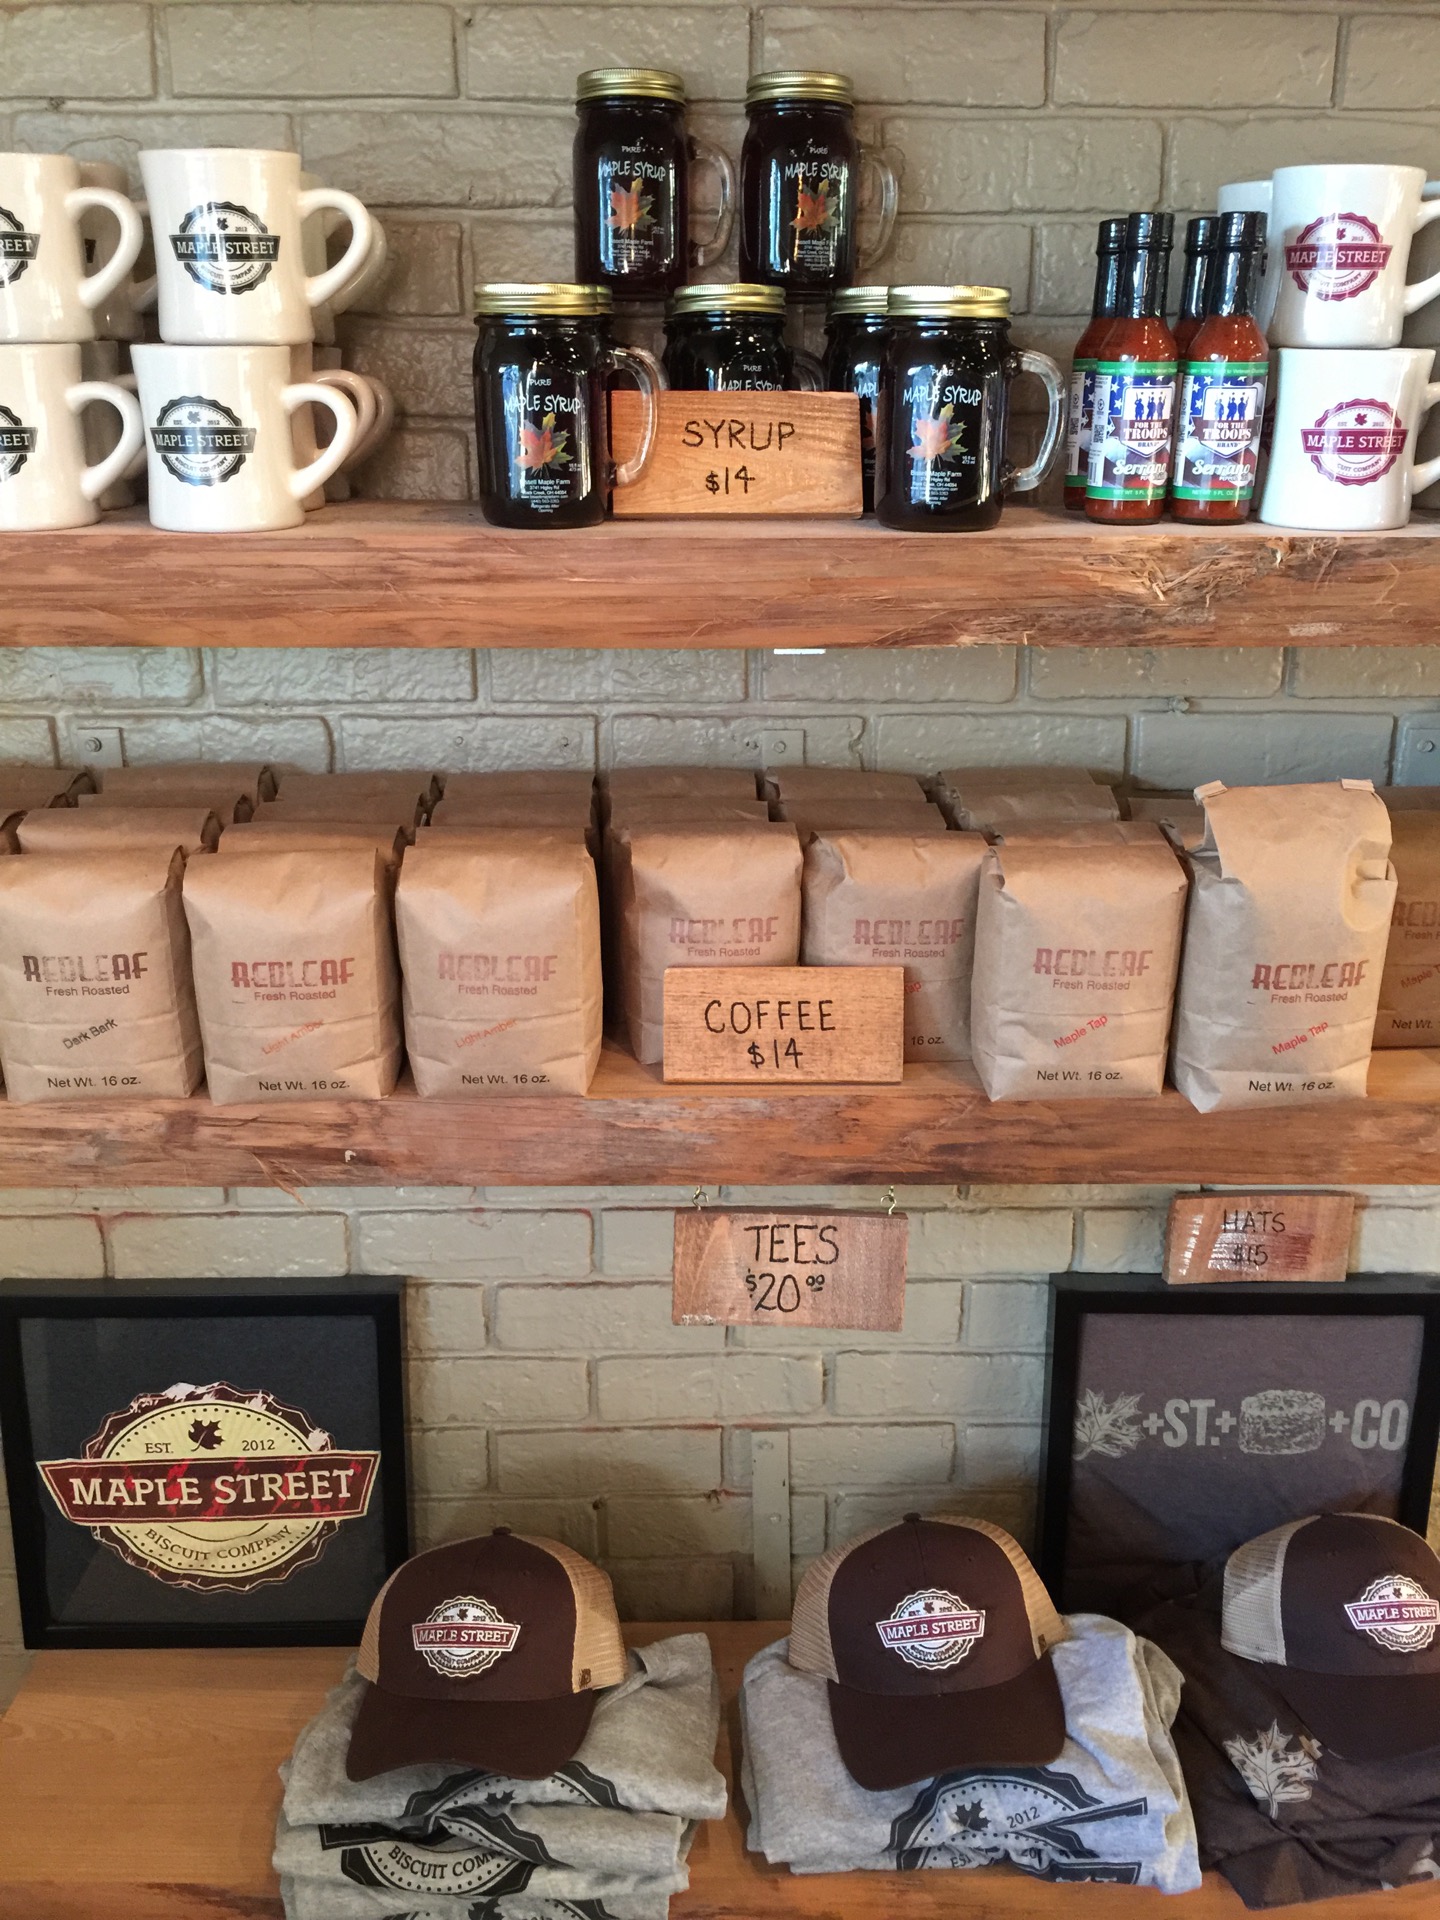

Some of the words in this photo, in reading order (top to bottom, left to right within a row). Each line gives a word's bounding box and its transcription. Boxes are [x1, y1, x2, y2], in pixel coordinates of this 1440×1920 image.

[632, 161, 667, 181] SYRUP
[785, 162, 818, 180] MAPLE
[177, 241, 219, 254] MAPLE
[225, 241, 275, 255] STREET
[1289, 251, 1334, 263] MAPLE
[1337, 251, 1386, 263] STREET
[229, 264, 255, 280] OMPANY
[743, 364, 762, 372] PURE
[853, 382, 879, 398] MAPL
[902, 383, 941, 405] MAPLE
[942, 385, 982, 406] SYRUP
[504, 394, 541, 415] MAPLE
[543, 395, 581, 415] SYRUP
[1134, 421, 1149, 429] FOR
[155, 434, 195, 447] MAPLE
[197, 434, 249, 447] STREET
[682, 419, 795, 450] SYRUP
[1123, 427, 1168, 440] TROOPS
[1203, 428, 1252, 440] TROOPS
[1306, 434, 1355, 448] MAPLE
[1358, 435, 1404, 448] STREET
[1112, 460, 1167, 476] Serrano
[1191, 460, 1251, 476] Serrano
[705, 465, 756, 494] $14
[1404, 930, 1433, 940] Fresh
[688, 947, 716, 956] Fresh
[719, 947, 761, 957] Roasted
[872, 948, 900, 958] Fresh
[903, 948, 945, 958] Roasted
[1052, 979, 1083, 990] Fresh
[1087, 980, 1131, 990] Roasted
[1400, 970, 1433, 988] Maple
[45, 986, 78, 996] Fresh
[81, 985, 130, 995] Roasted
[254, 991, 286, 1000] Fresh
[289, 989, 336, 1000] Roasted
[458, 984, 489, 995] Fresh
[492, 984, 538, 996] Roasted
[904, 982, 922, 993] ap
[1270, 993, 1301, 1004] Fresh
[1304, 992, 1349, 1002] Roasted
[704, 999, 836, 1034] COFFEE
[1391, 1019, 1412, 1029] Net
[62, 1032, 91, 1049] Dark
[88, 1018, 118, 1037] Bark
[454, 1032, 481, 1048] Light
[483, 1018, 518, 1038] Amber
[1053, 1028, 1087, 1048] Maple
[1086, 1015, 1108, 1031] Tap
[1271, 1034, 1308, 1055] Maple
[1308, 1021, 1329, 1037] Tap
[911, 1036, 925, 1046] 16
[927, 1036, 945, 1045] oz.
[747, 1038, 803, 1069] $14
[47, 1077, 71, 1088] Net
[73, 1077, 97, 1087] Wt.
[101, 1075, 118, 1086] 16
[121, 1077, 142, 1085] oz.
[461, 1075, 484, 1084] Net
[486, 1075, 508, 1084] Wt.
[512, 1074, 528, 1083] 16
[531, 1075, 550, 1083] oz.
[1036, 1070, 1058, 1080] Net
[1062, 1071, 1082, 1080] Wt.
[1088, 1071, 1102, 1080] 16
[1105, 1072, 1123, 1080] oz.
[258, 1081, 283, 1091] Net
[284, 1081, 307, 1091] Wt.
[311, 1080, 327, 1090] 16
[330, 1080, 350, 1089] oz.
[1248, 1080, 1272, 1092] Net
[1275, 1082, 1294, 1092] Wt.
[1301, 1081, 1315, 1091] 16
[1317, 1081, 1336, 1089] oz.
[1223, 1208, 1286, 1234] HATS
[743, 1223, 840, 1265] TEES
[1230, 1244, 1269, 1267] $15
[145, 1442, 174, 1454] EST.
[242, 1439, 276, 1452] 2012
[70, 1476, 203, 1507] MAPLE
[214, 1468, 355, 1504] STREET
[144, 1528, 211, 1561] BISCUIT
[217, 1525, 293, 1560] COMPANY
[1356, 1607, 1400, 1621] MAPLE
[1402, 1606, 1436, 1618] STREET
[419, 1630, 458, 1643] MAPLE
[460, 1630, 509, 1643] STREET
[885, 1623, 929, 1640] MAPLE
[931, 1618, 978, 1635] STREET
[1006, 1806, 1040, 1828] 2012
[388, 1845, 448, 1879] BISCUIT
